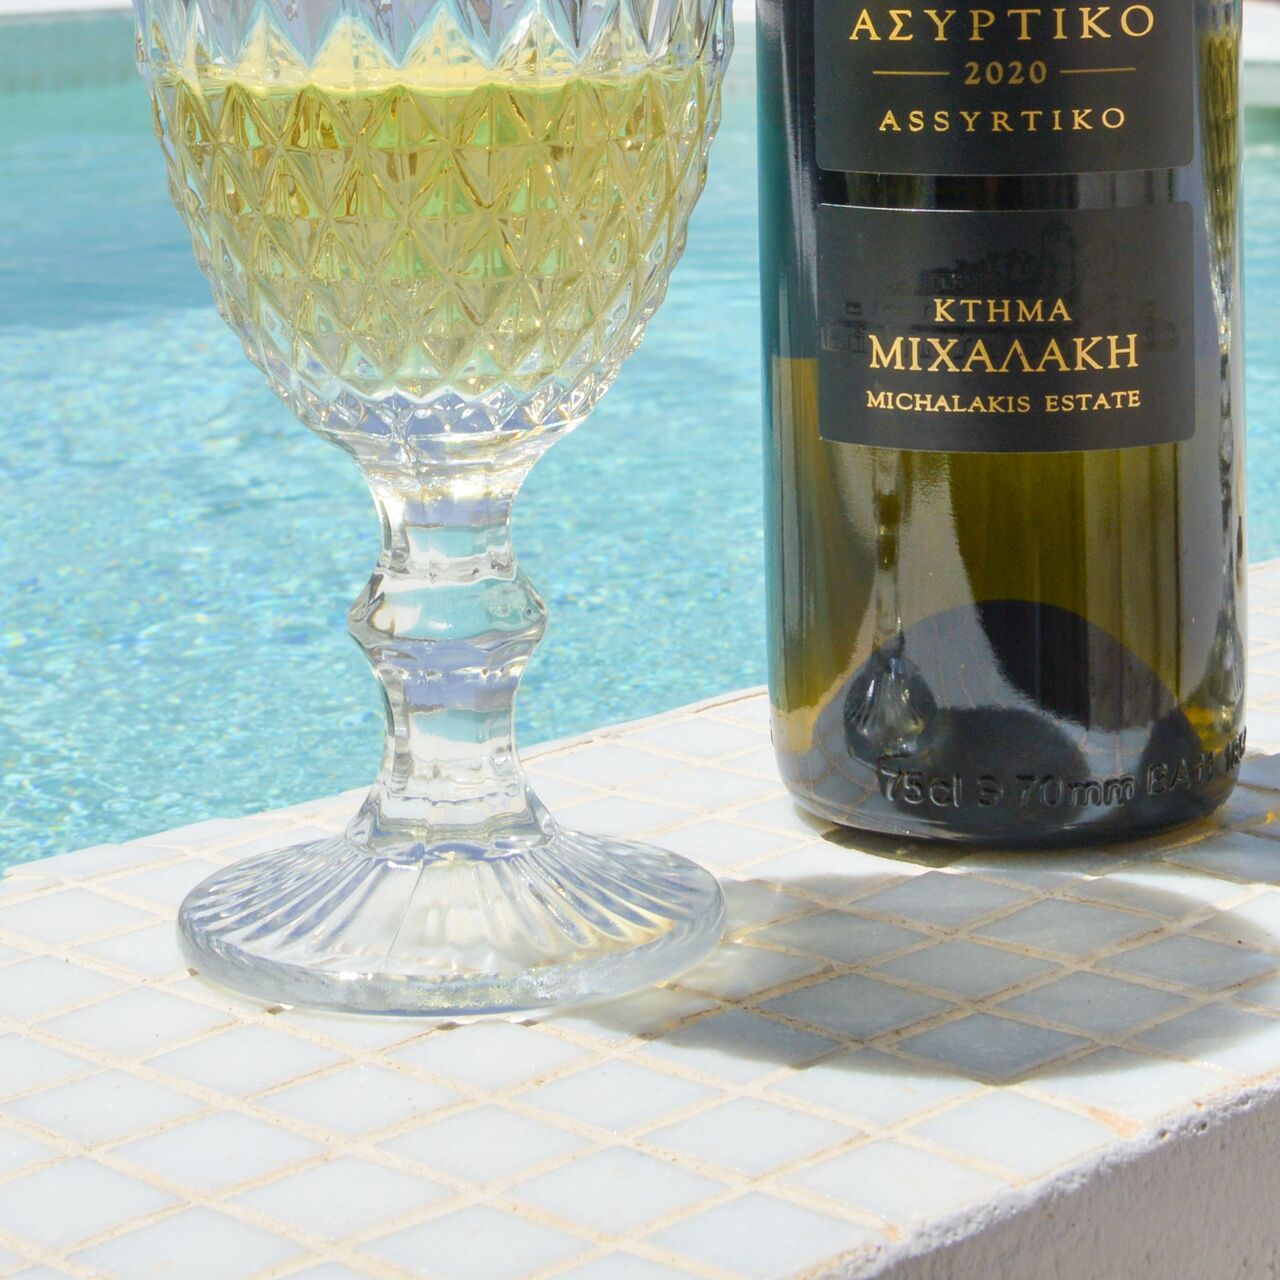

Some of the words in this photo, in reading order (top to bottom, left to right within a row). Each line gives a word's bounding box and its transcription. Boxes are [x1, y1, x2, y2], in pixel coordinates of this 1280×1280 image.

[848, 3, 1156, 42] ΑΣΥΡΤΙΚΟ
[964, 60, 1048, 86] 2020
[878, 106, 1126, 133] ASSYRTIKO
[933, 297, 1072, 323] ΚΤΗΜΑ
[868, 332, 1140, 373] ΜΙΧΑΛΑΚΗ
[865, 389, 1031, 415] MICHALAKIS
[1044, 388, 1142, 413] ESTATE
